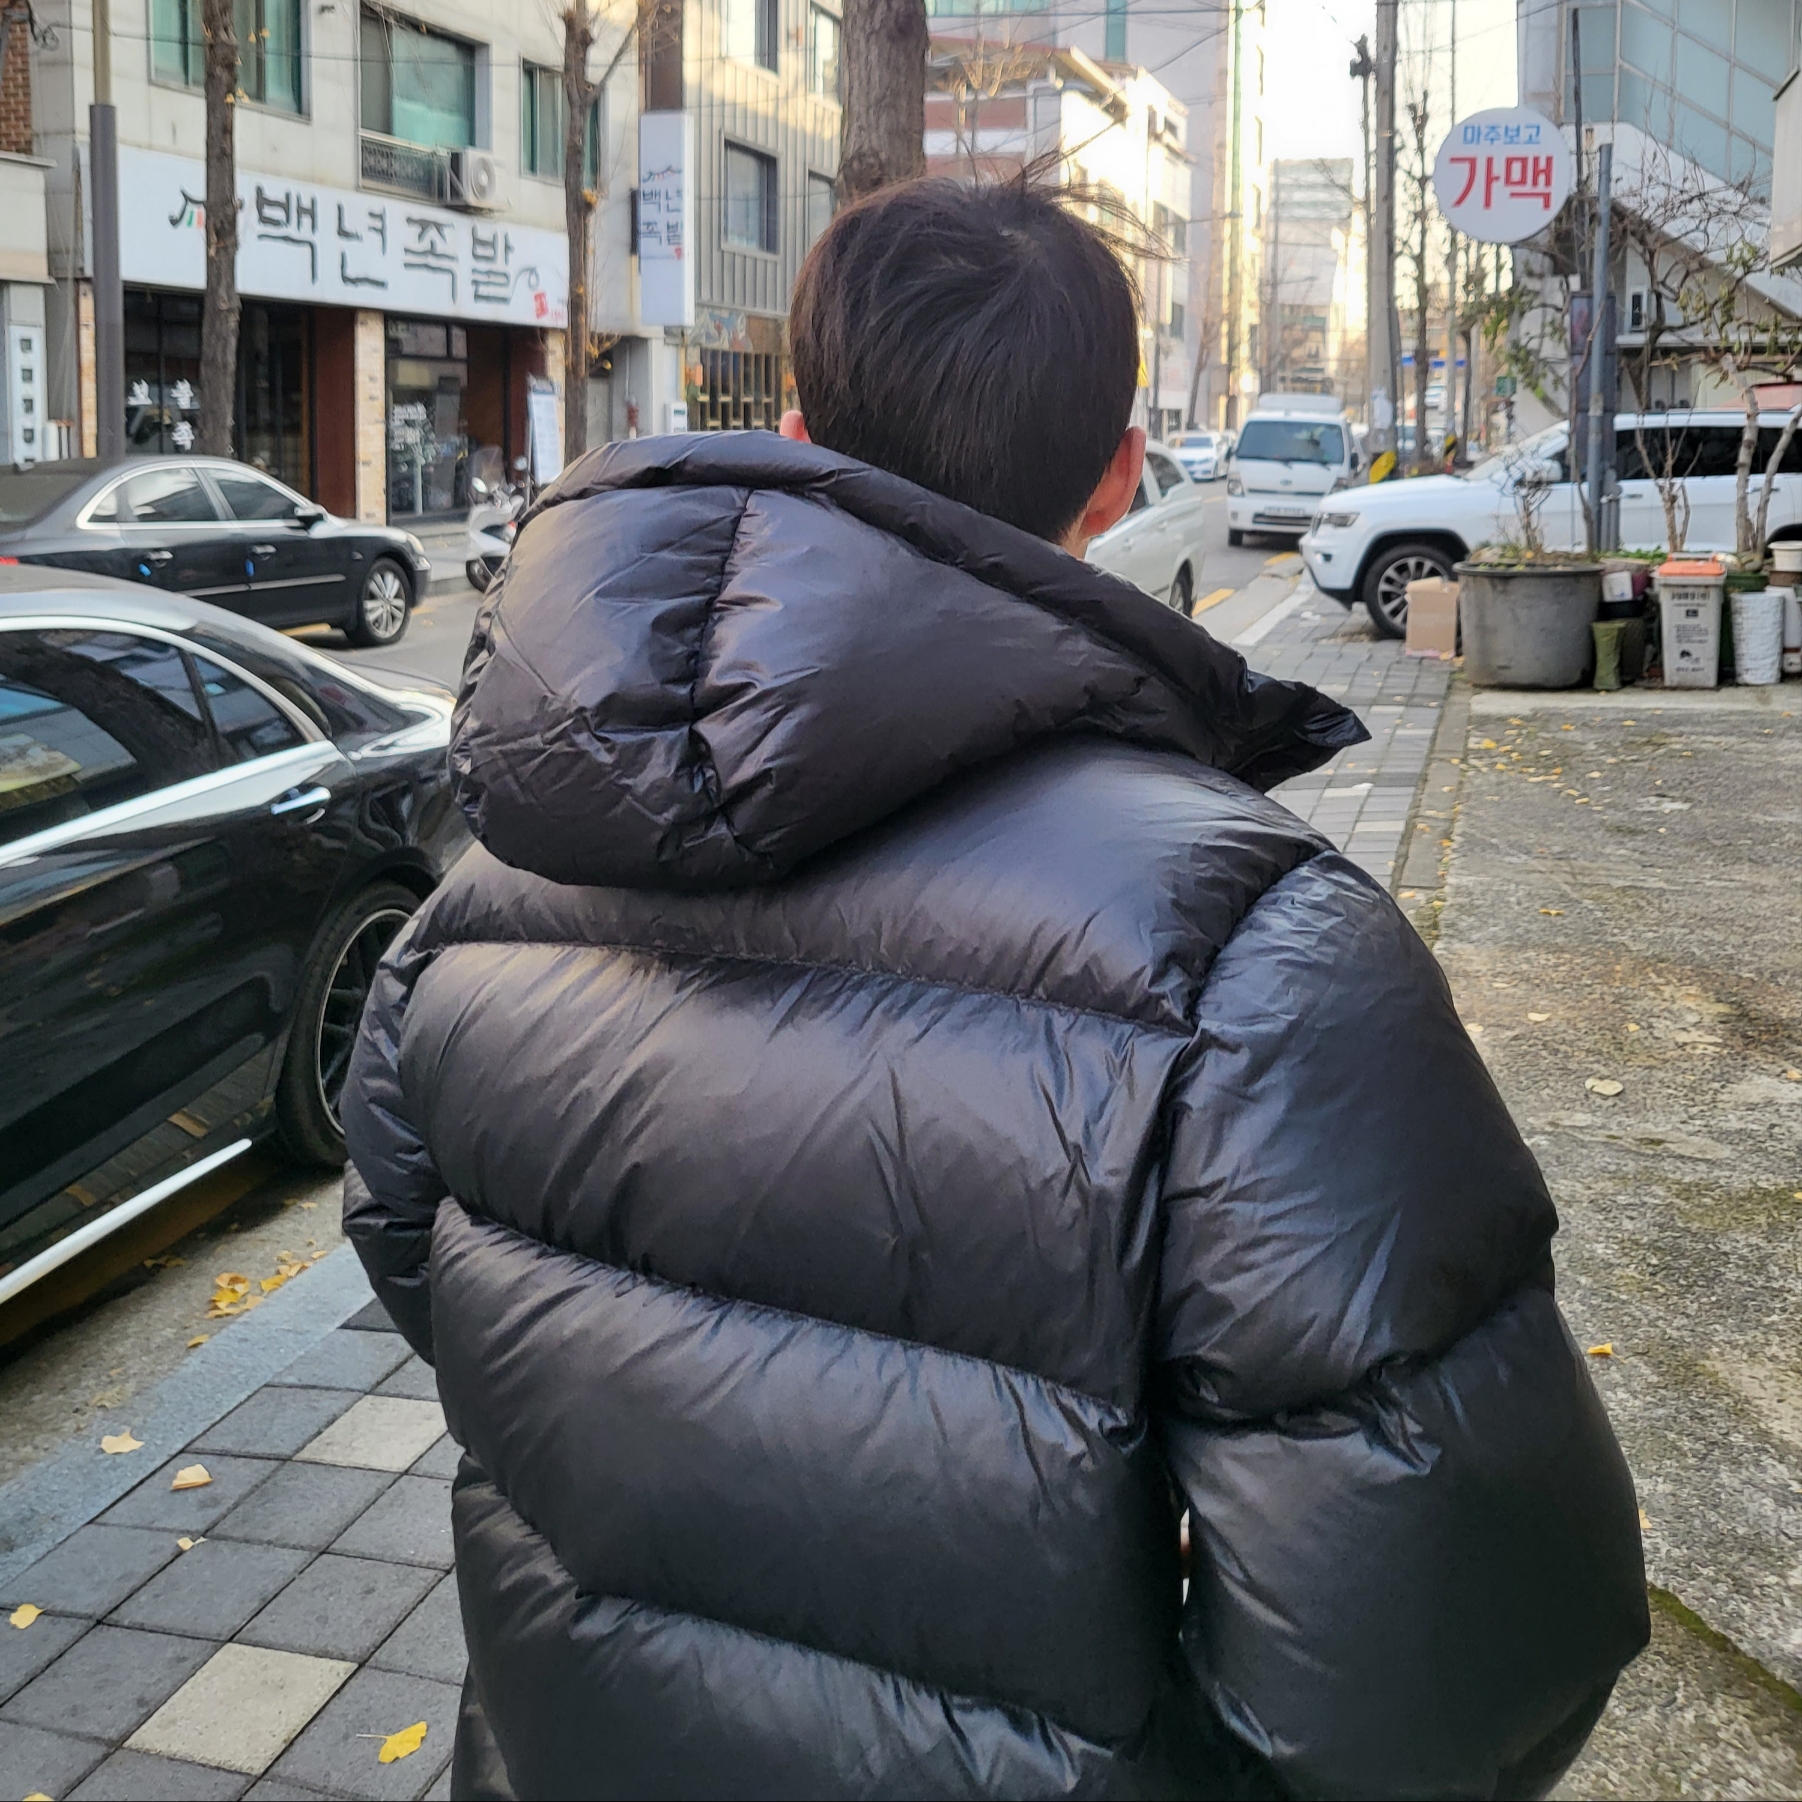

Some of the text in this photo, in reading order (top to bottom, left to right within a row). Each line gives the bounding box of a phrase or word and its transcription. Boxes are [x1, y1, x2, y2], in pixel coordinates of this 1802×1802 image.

[1462, 124, 1541, 145] 마주보고
[642, 188, 682, 213] 백년
[1448, 155, 1553, 210] 가맥
[256, 185, 515, 305] 백년족발
